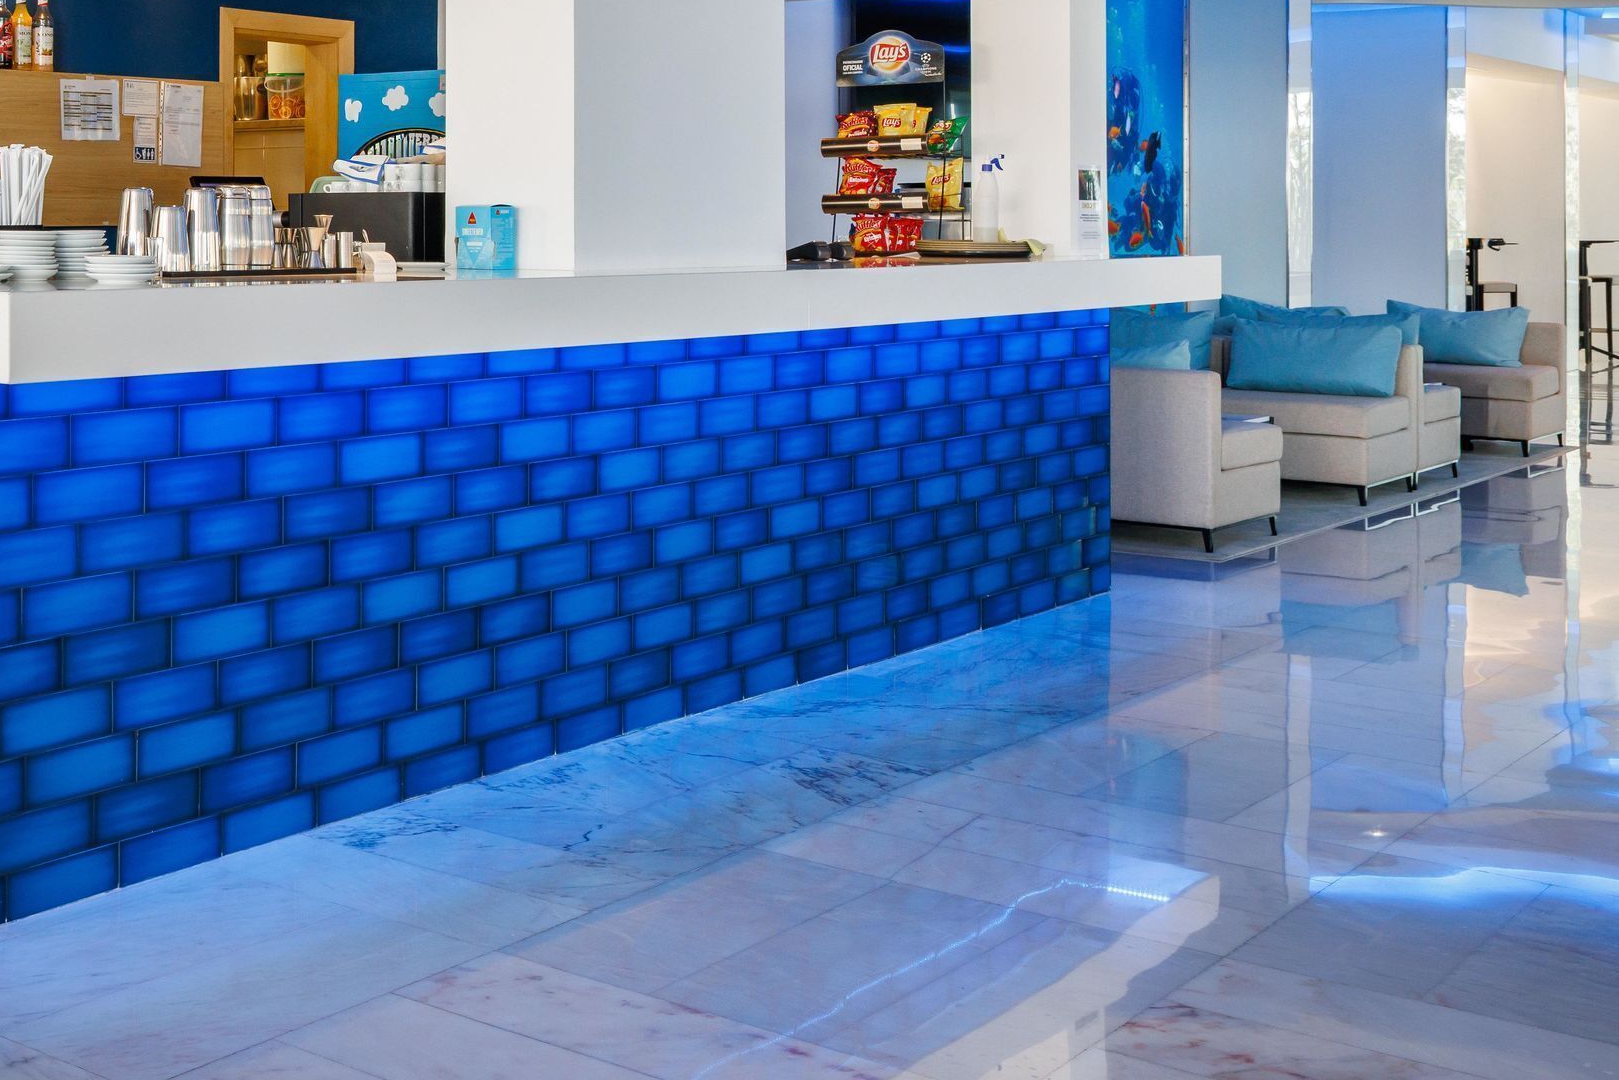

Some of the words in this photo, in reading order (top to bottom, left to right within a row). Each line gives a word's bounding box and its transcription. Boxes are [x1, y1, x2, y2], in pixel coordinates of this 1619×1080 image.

[872, 43, 907, 63] Lay's
[842, 64, 863, 72] OFICIAL
[883, 118, 901, 128] Lay's
[845, 162, 873, 173] Ruffles
